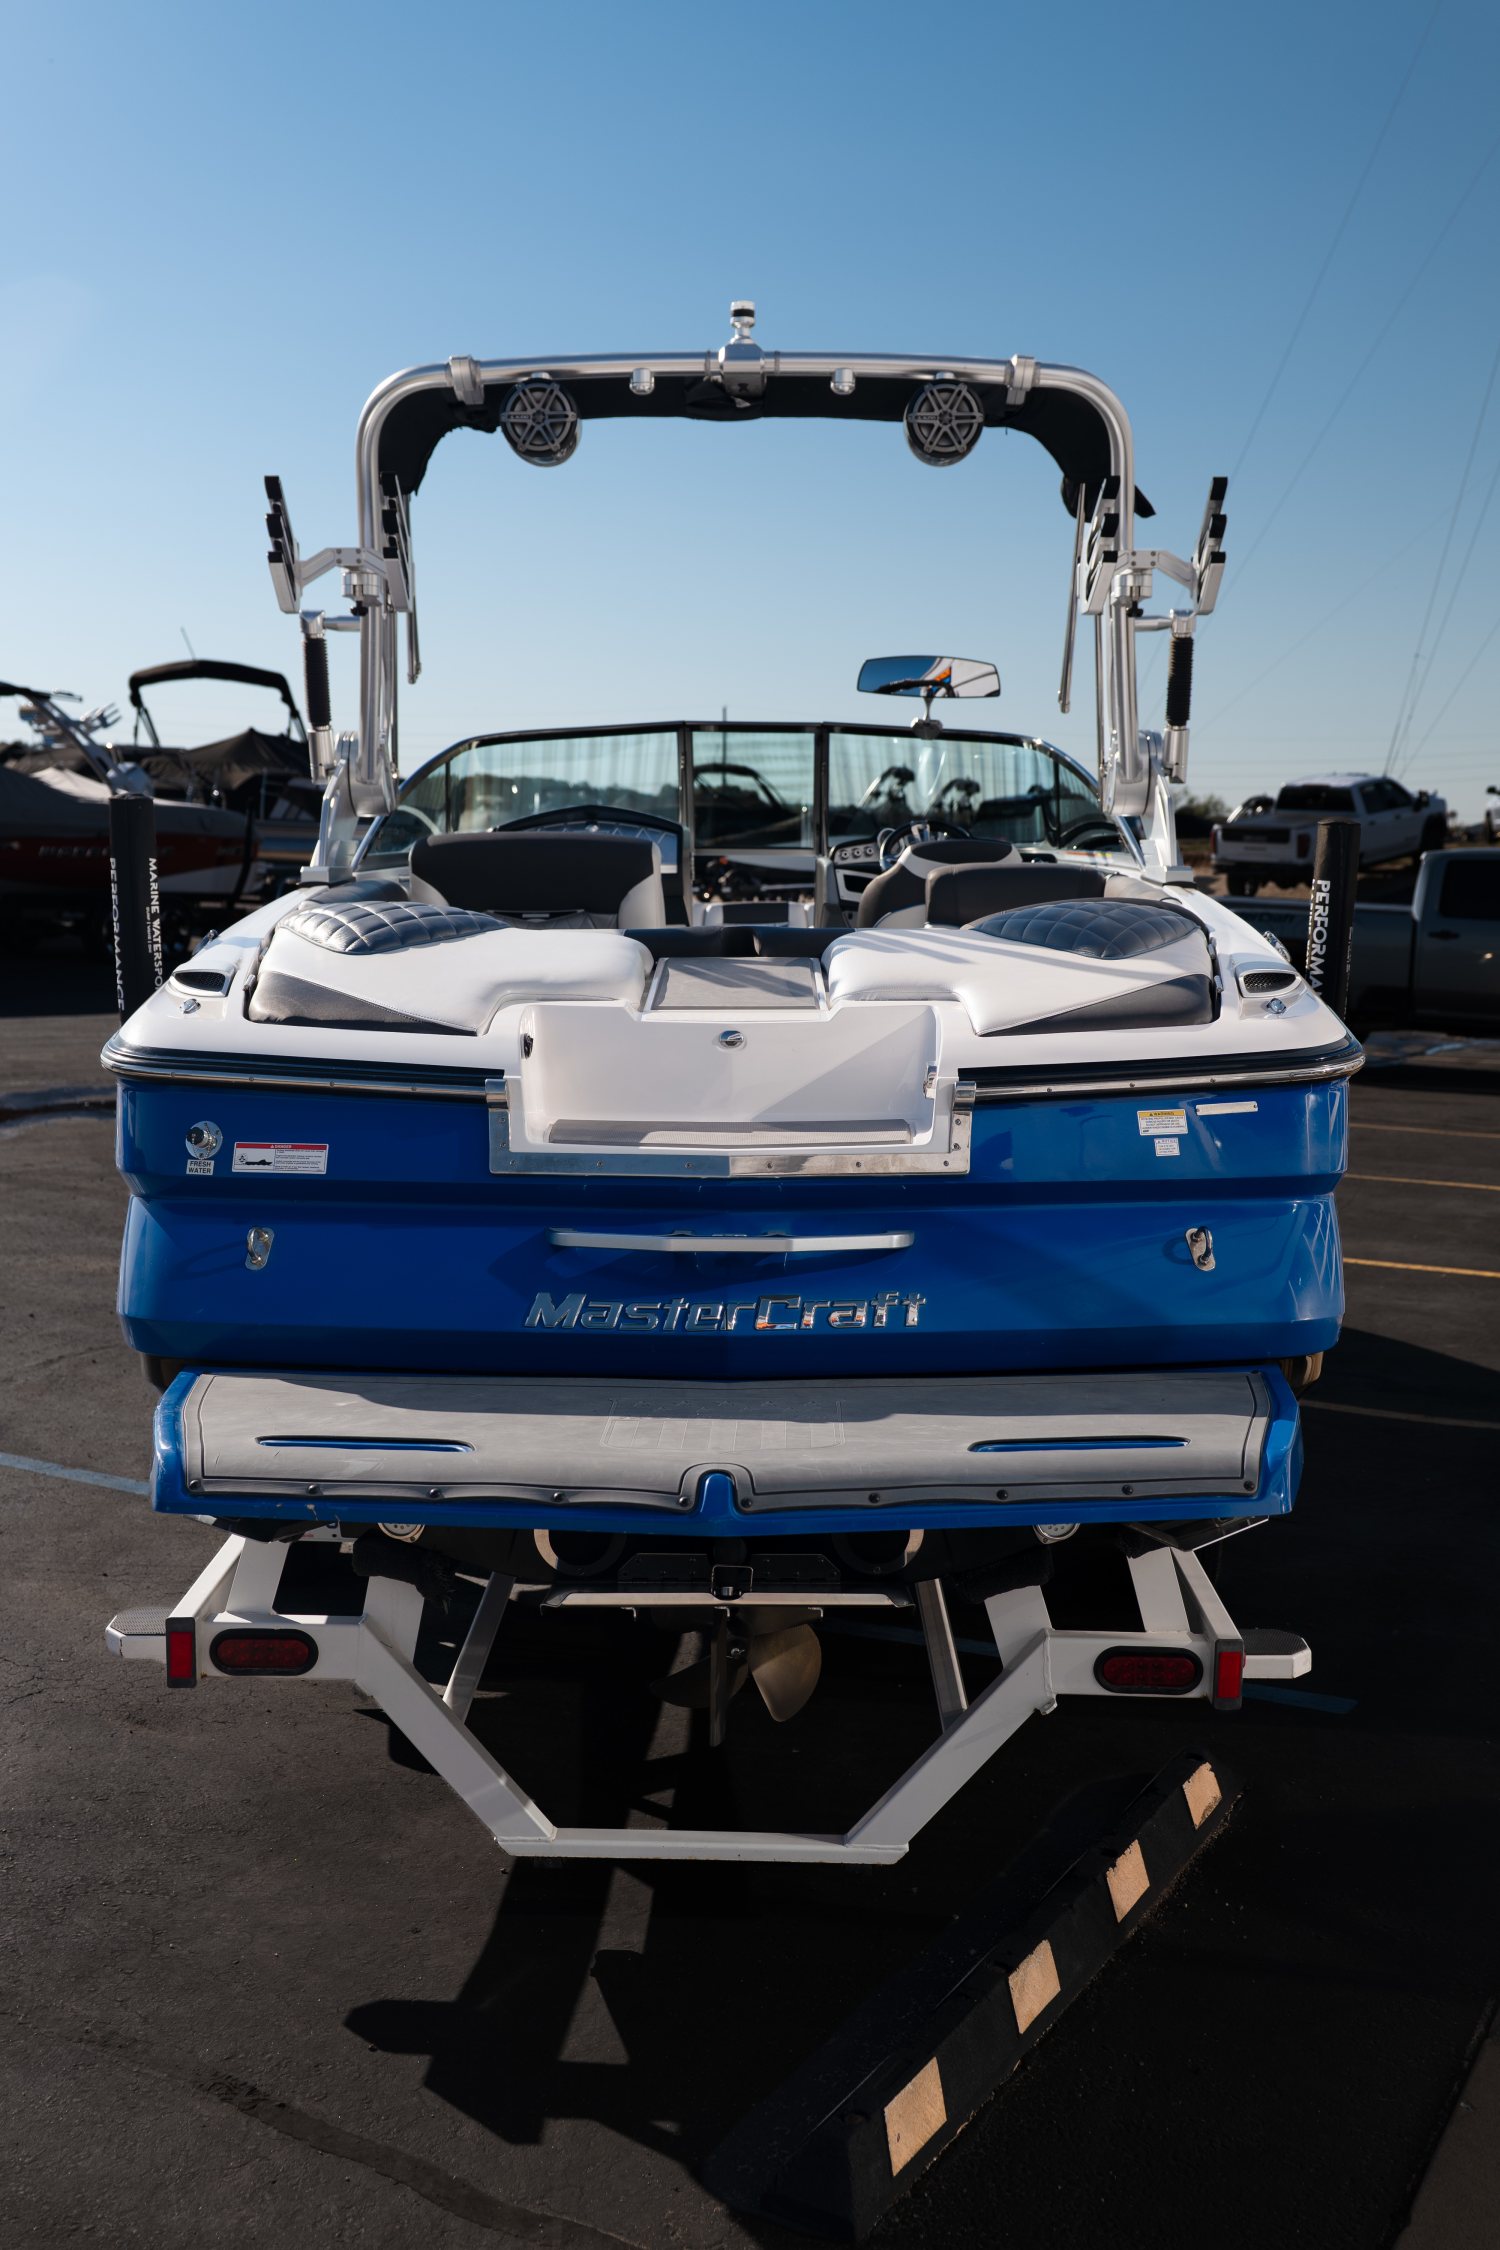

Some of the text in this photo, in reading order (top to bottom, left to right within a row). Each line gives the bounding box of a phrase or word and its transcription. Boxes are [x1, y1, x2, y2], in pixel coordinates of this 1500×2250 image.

[148, 857, 164, 992] MARINE WATERSPO
[188, 1167, 212, 1175] WATER
[189, 1160, 212, 1168] FRESH
[524, 1291, 927, 1332] MasterCraft
